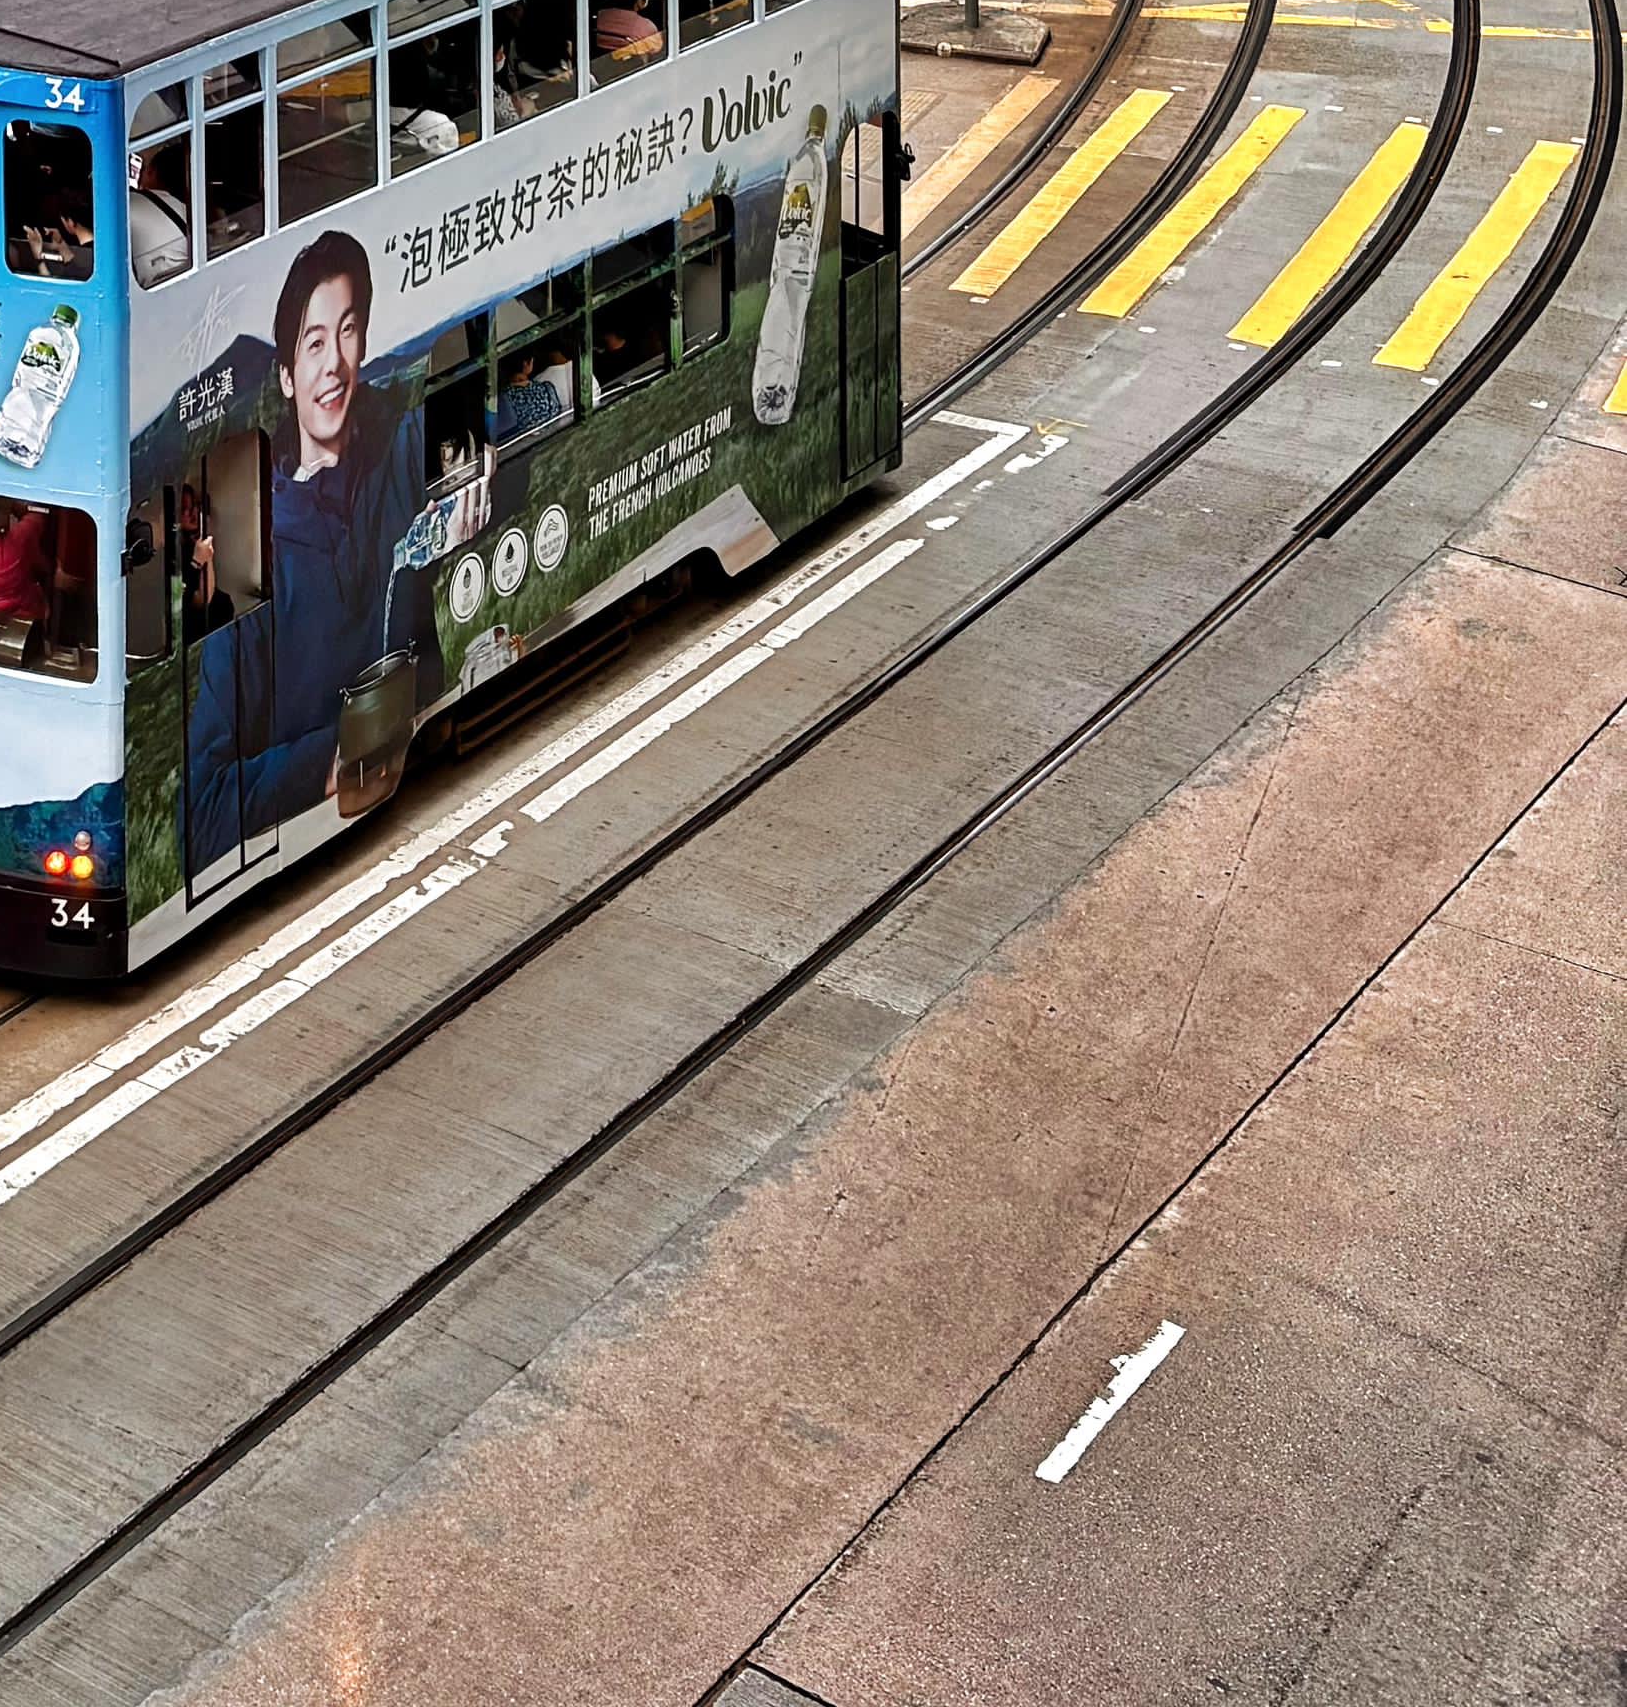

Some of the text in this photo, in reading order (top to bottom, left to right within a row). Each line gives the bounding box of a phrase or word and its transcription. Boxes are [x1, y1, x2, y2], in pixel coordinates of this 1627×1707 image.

[45, 77, 85, 112] 34
[178, 367, 234, 422] 許光漢
[588, 405, 732, 512] PREMIUM SOFT WATER FROM
[588, 446, 712, 540] THE FRENCH VOLCANOES
[50, 898, 95, 930] 34
